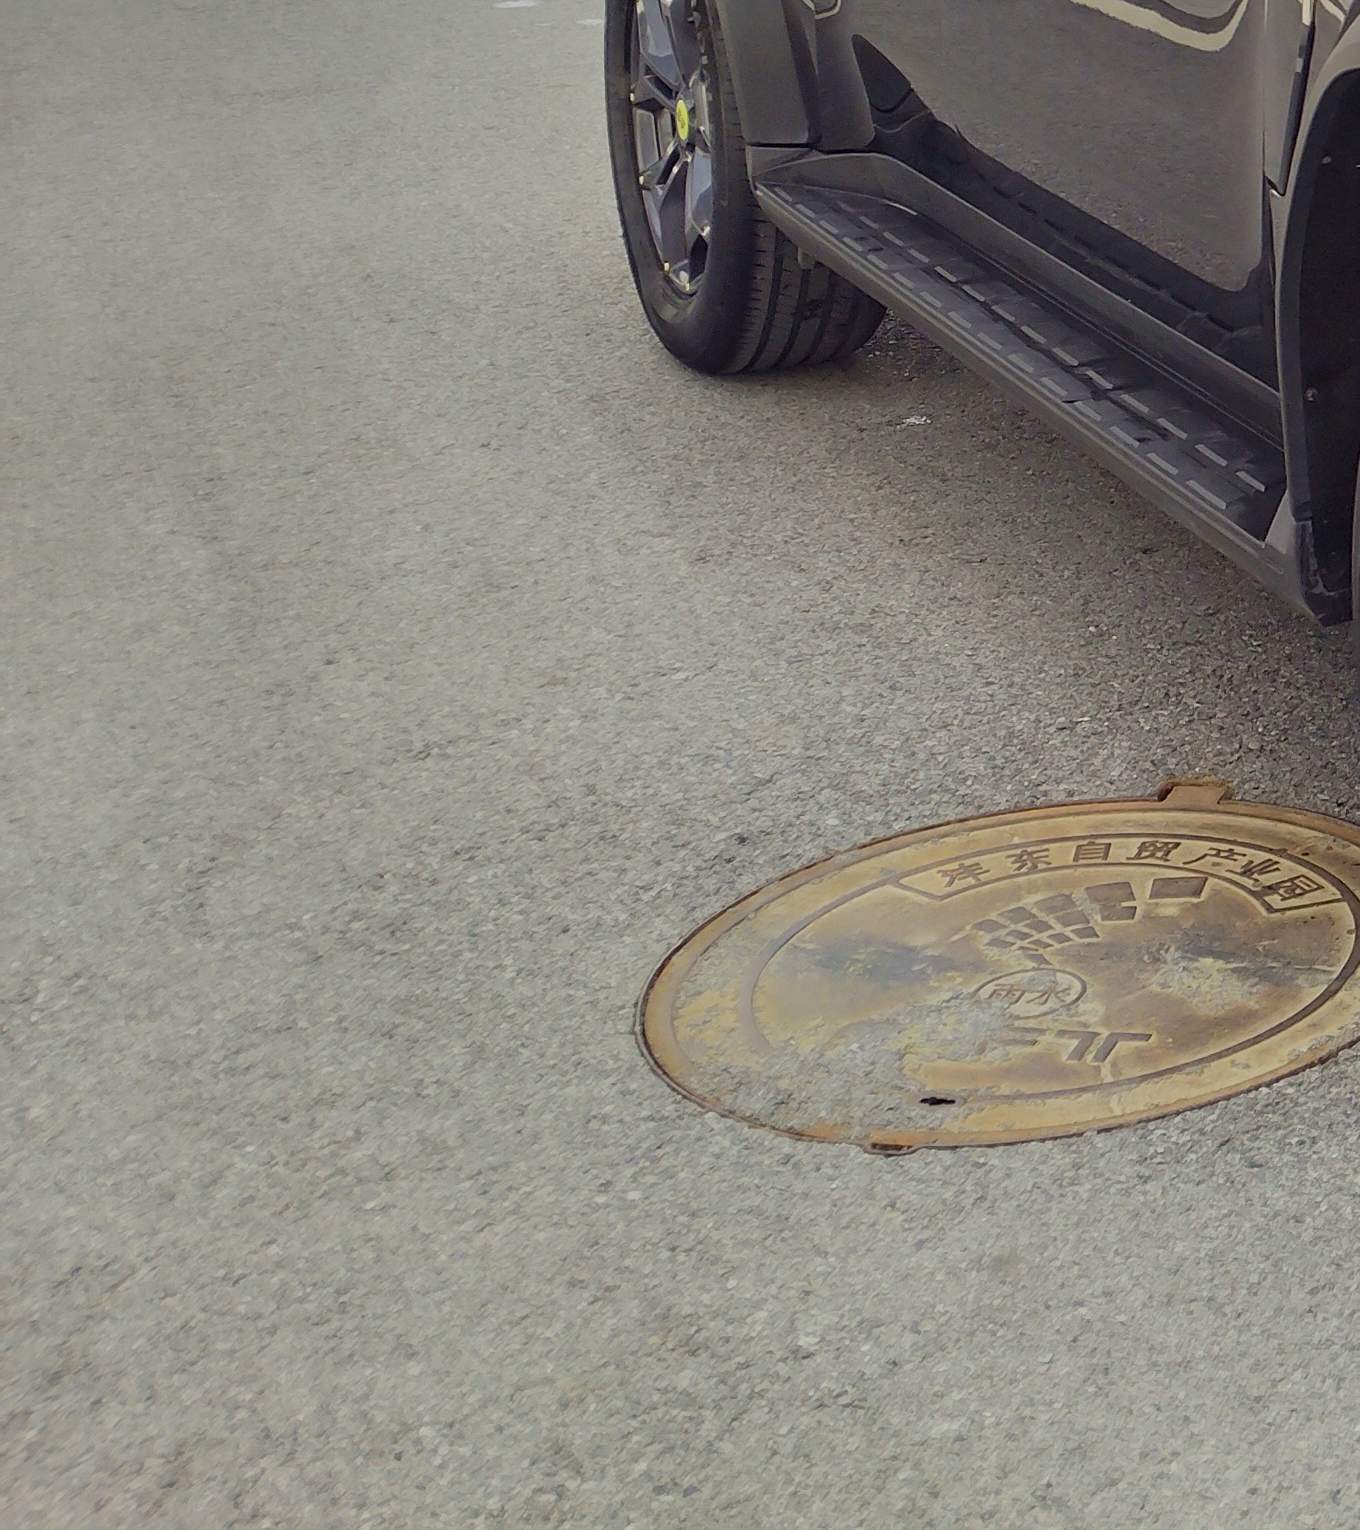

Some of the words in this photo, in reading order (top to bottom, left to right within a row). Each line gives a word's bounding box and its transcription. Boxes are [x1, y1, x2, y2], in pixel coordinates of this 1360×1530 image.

[937, 840, 1325, 901] 沣东自贸产业园
[986, 980, 1072, 1006] 雨水
